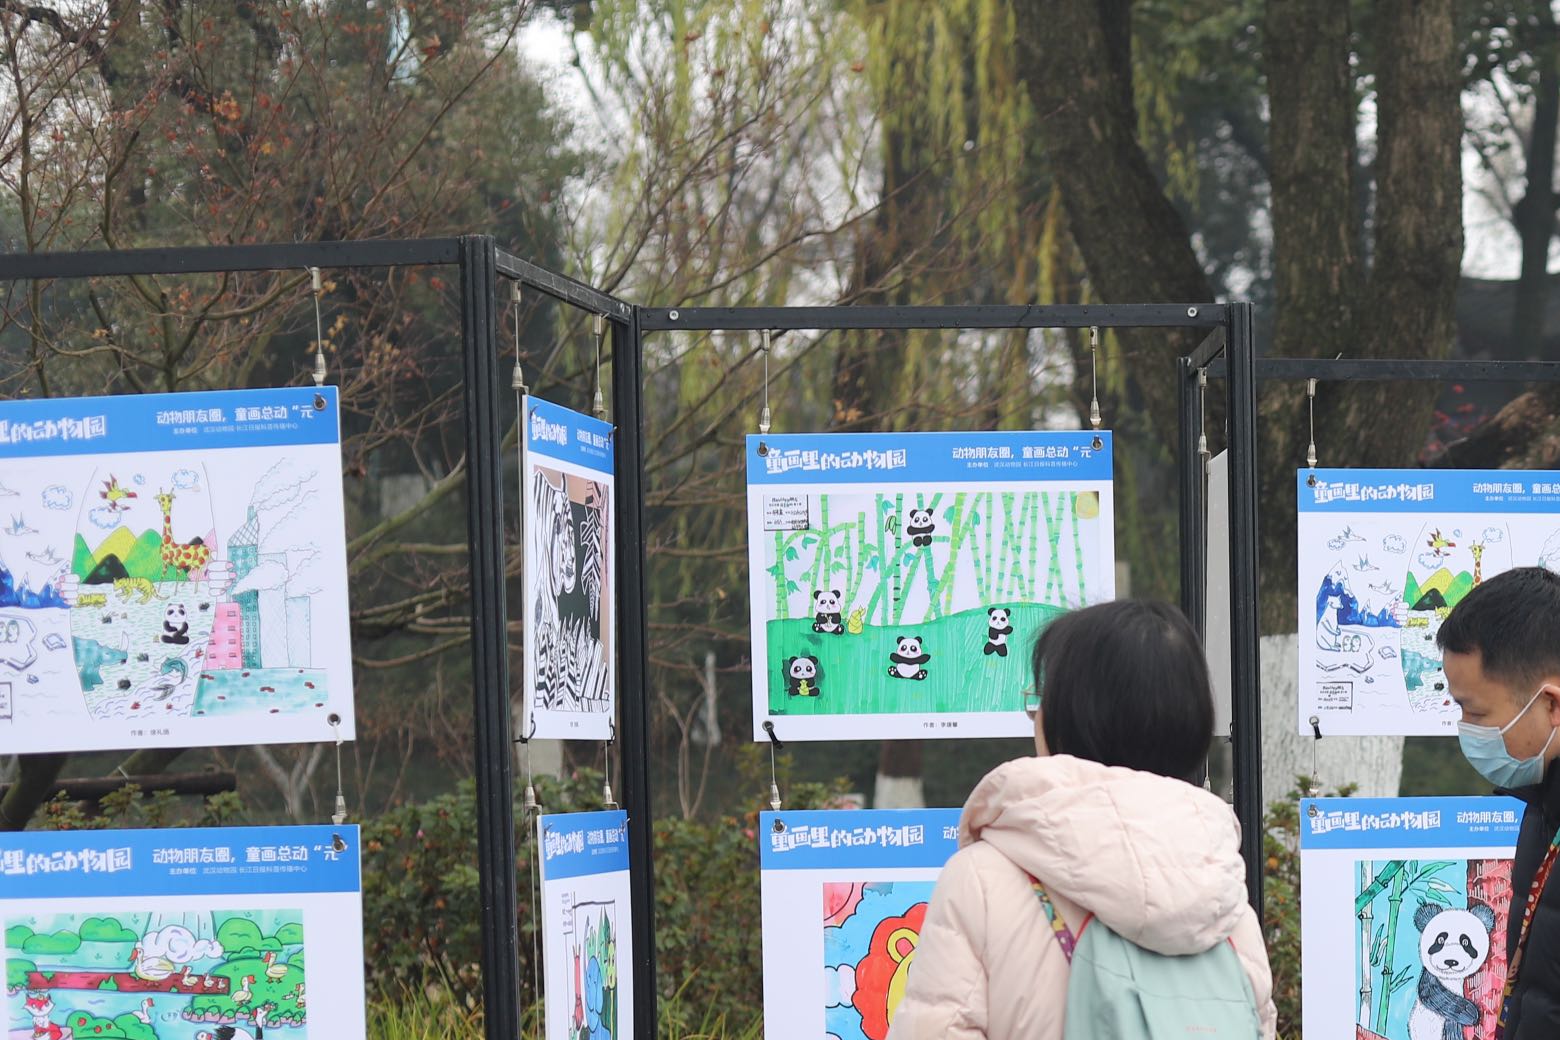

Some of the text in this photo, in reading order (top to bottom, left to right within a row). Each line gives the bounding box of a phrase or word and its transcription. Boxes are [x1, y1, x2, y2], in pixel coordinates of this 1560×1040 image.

[766, 447, 906, 474] 童画里的动物园
[1314, 482, 1434, 504] 童画里的动物园
[943, 827, 961, 840] 动
[1309, 810, 1441, 834] 童画里的动物园
[771, 825, 924, 852] 童画里的动物园
[0, 847, 131, 874] 里的动物园
